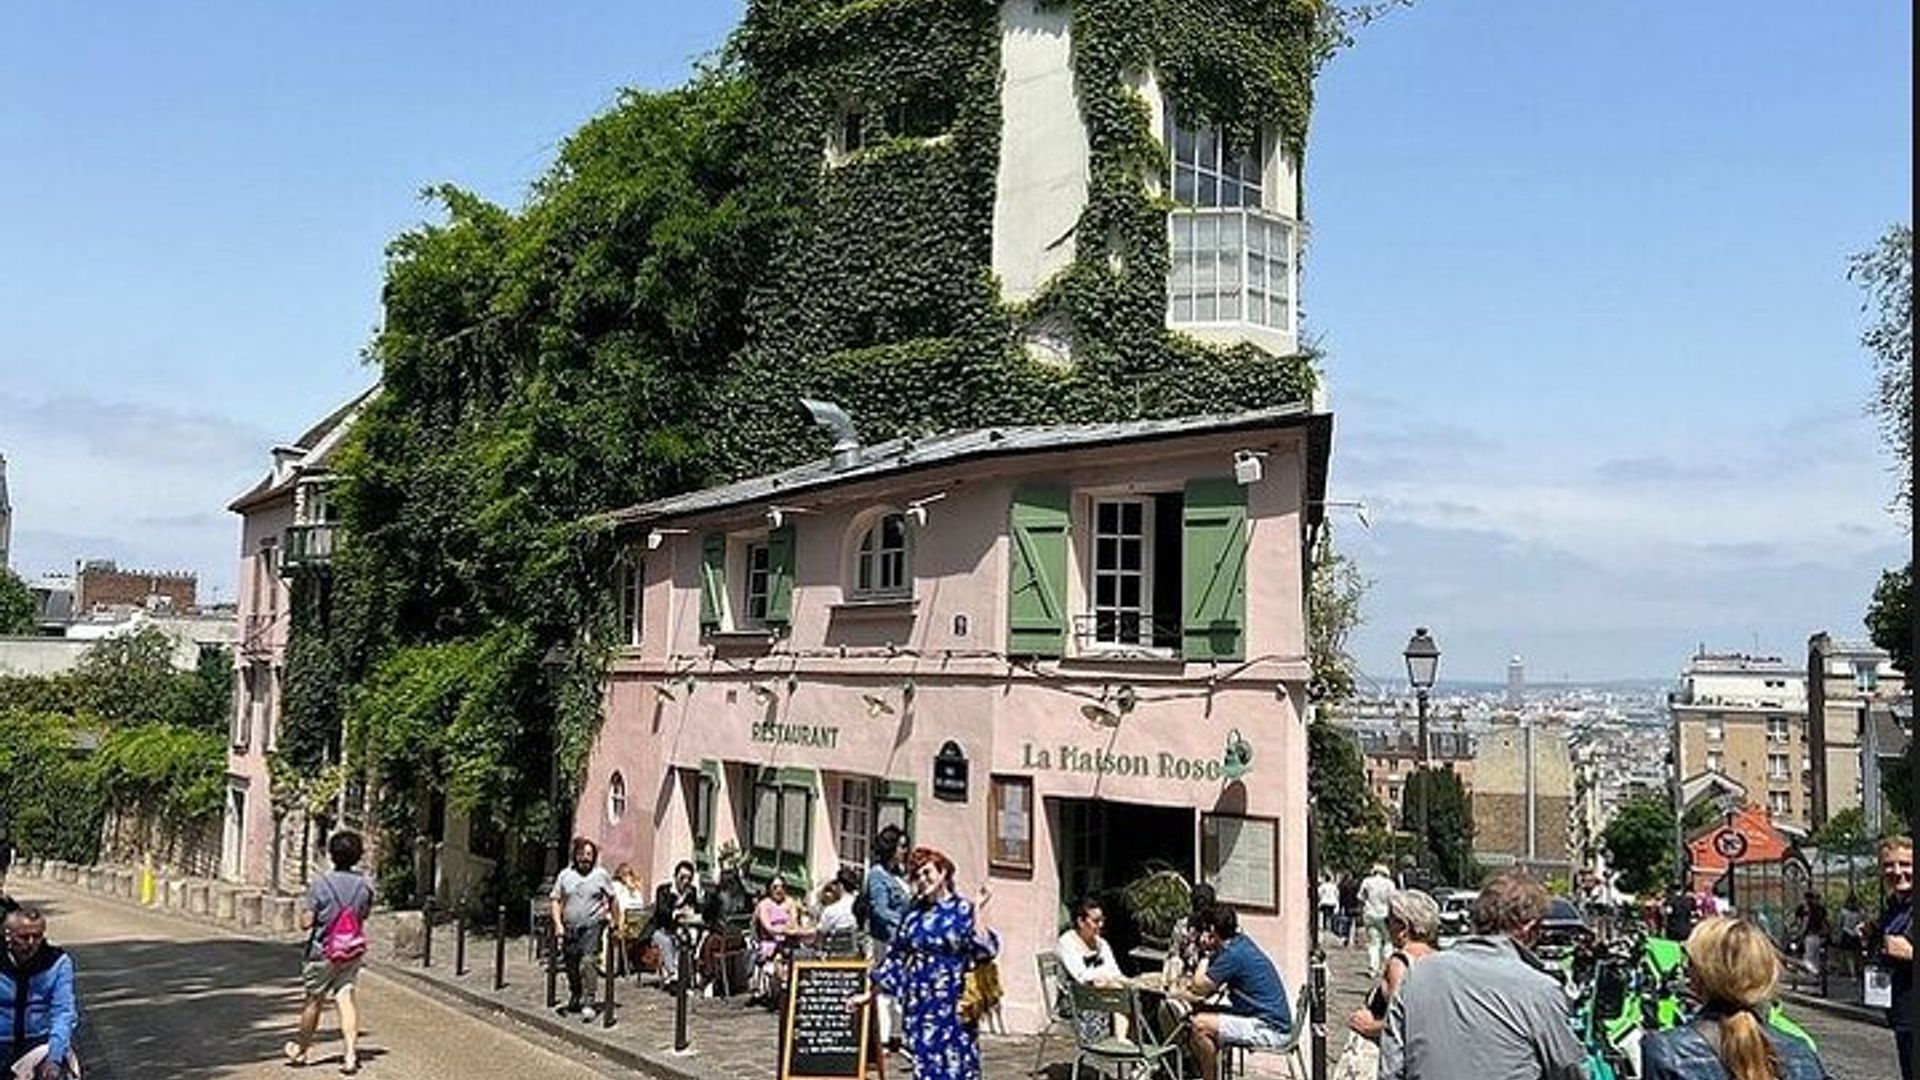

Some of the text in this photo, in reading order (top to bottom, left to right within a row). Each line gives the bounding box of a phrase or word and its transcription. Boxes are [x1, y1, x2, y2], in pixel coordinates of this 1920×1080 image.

[752, 721, 839, 748] RESTAURANT
[1022, 743, 1050, 769] La
[1059, 746, 1149, 777] Maison
